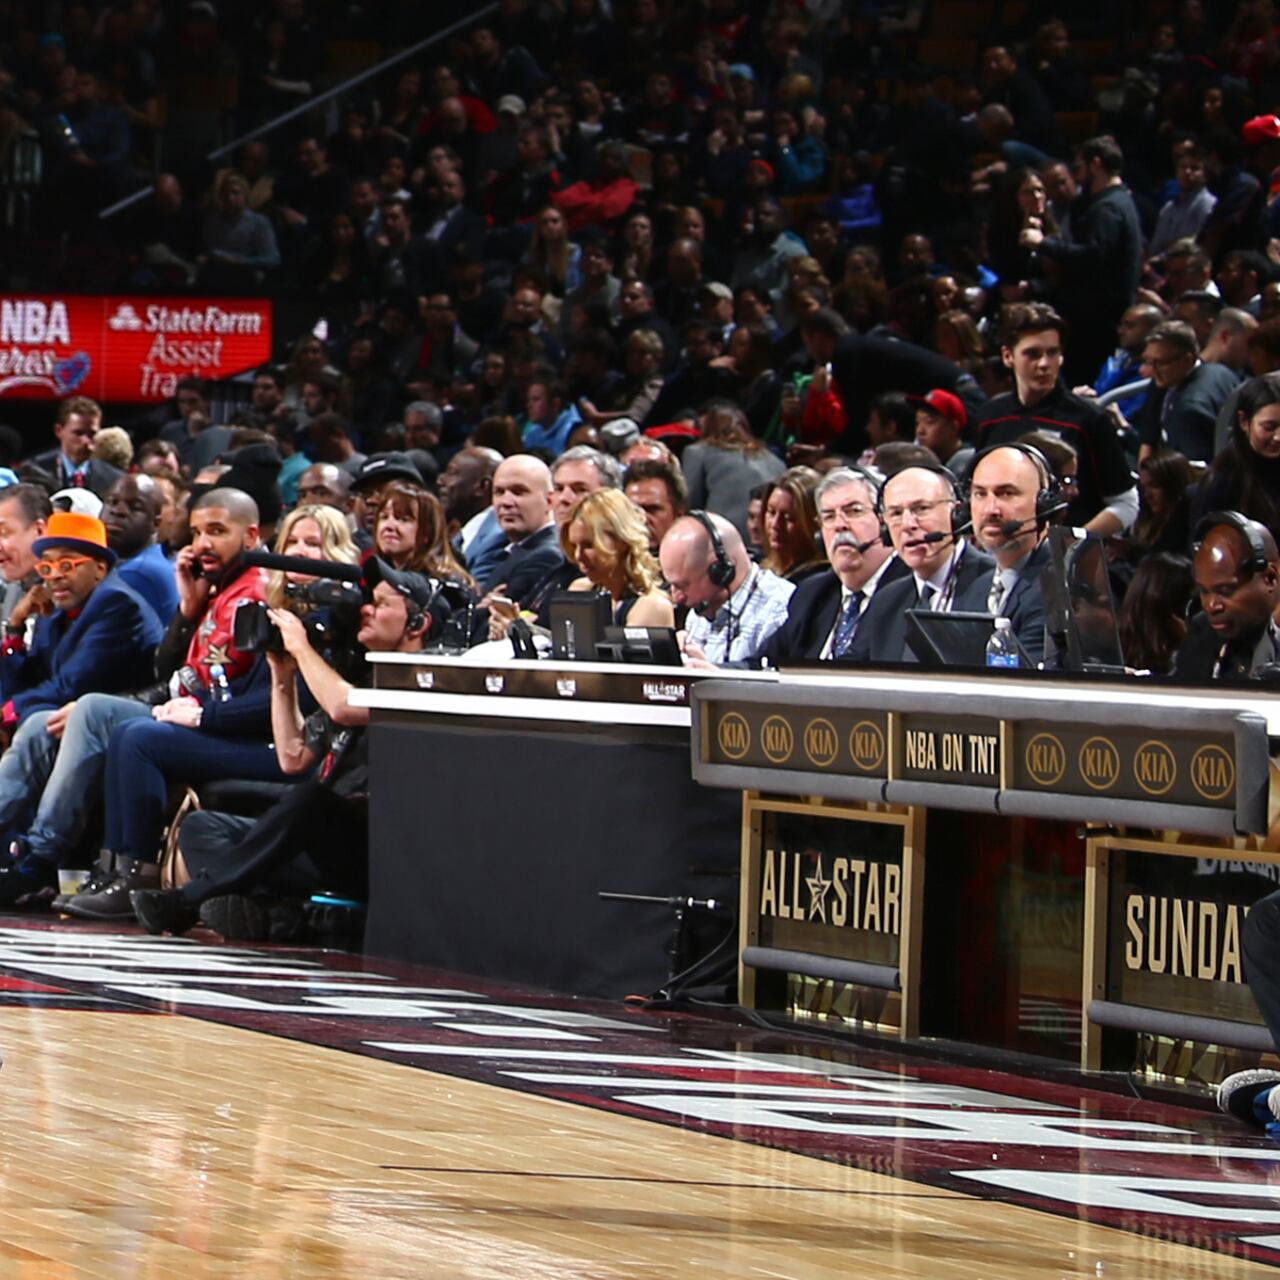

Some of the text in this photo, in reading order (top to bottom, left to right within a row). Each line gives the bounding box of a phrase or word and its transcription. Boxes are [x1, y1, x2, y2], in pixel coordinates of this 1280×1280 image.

[0, 300, 70, 344] NBA
[148, 333, 223, 368] Assist
[722, 722, 746, 750] KIA
[766, 726, 789, 753] KIA
[809, 728, 833, 756] KIA
[854, 732, 879, 760] KIA
[906, 730, 997, 775] NBA ON TNT
[1031, 744, 1059, 773] KIA
[1085, 748, 1113, 778] KIA
[1140, 752, 1170, 783] KIA
[1197, 756, 1228, 788] KIA
[760, 849, 901, 935] ALL STAR
[1125, 894, 1252, 985] SUNDA
